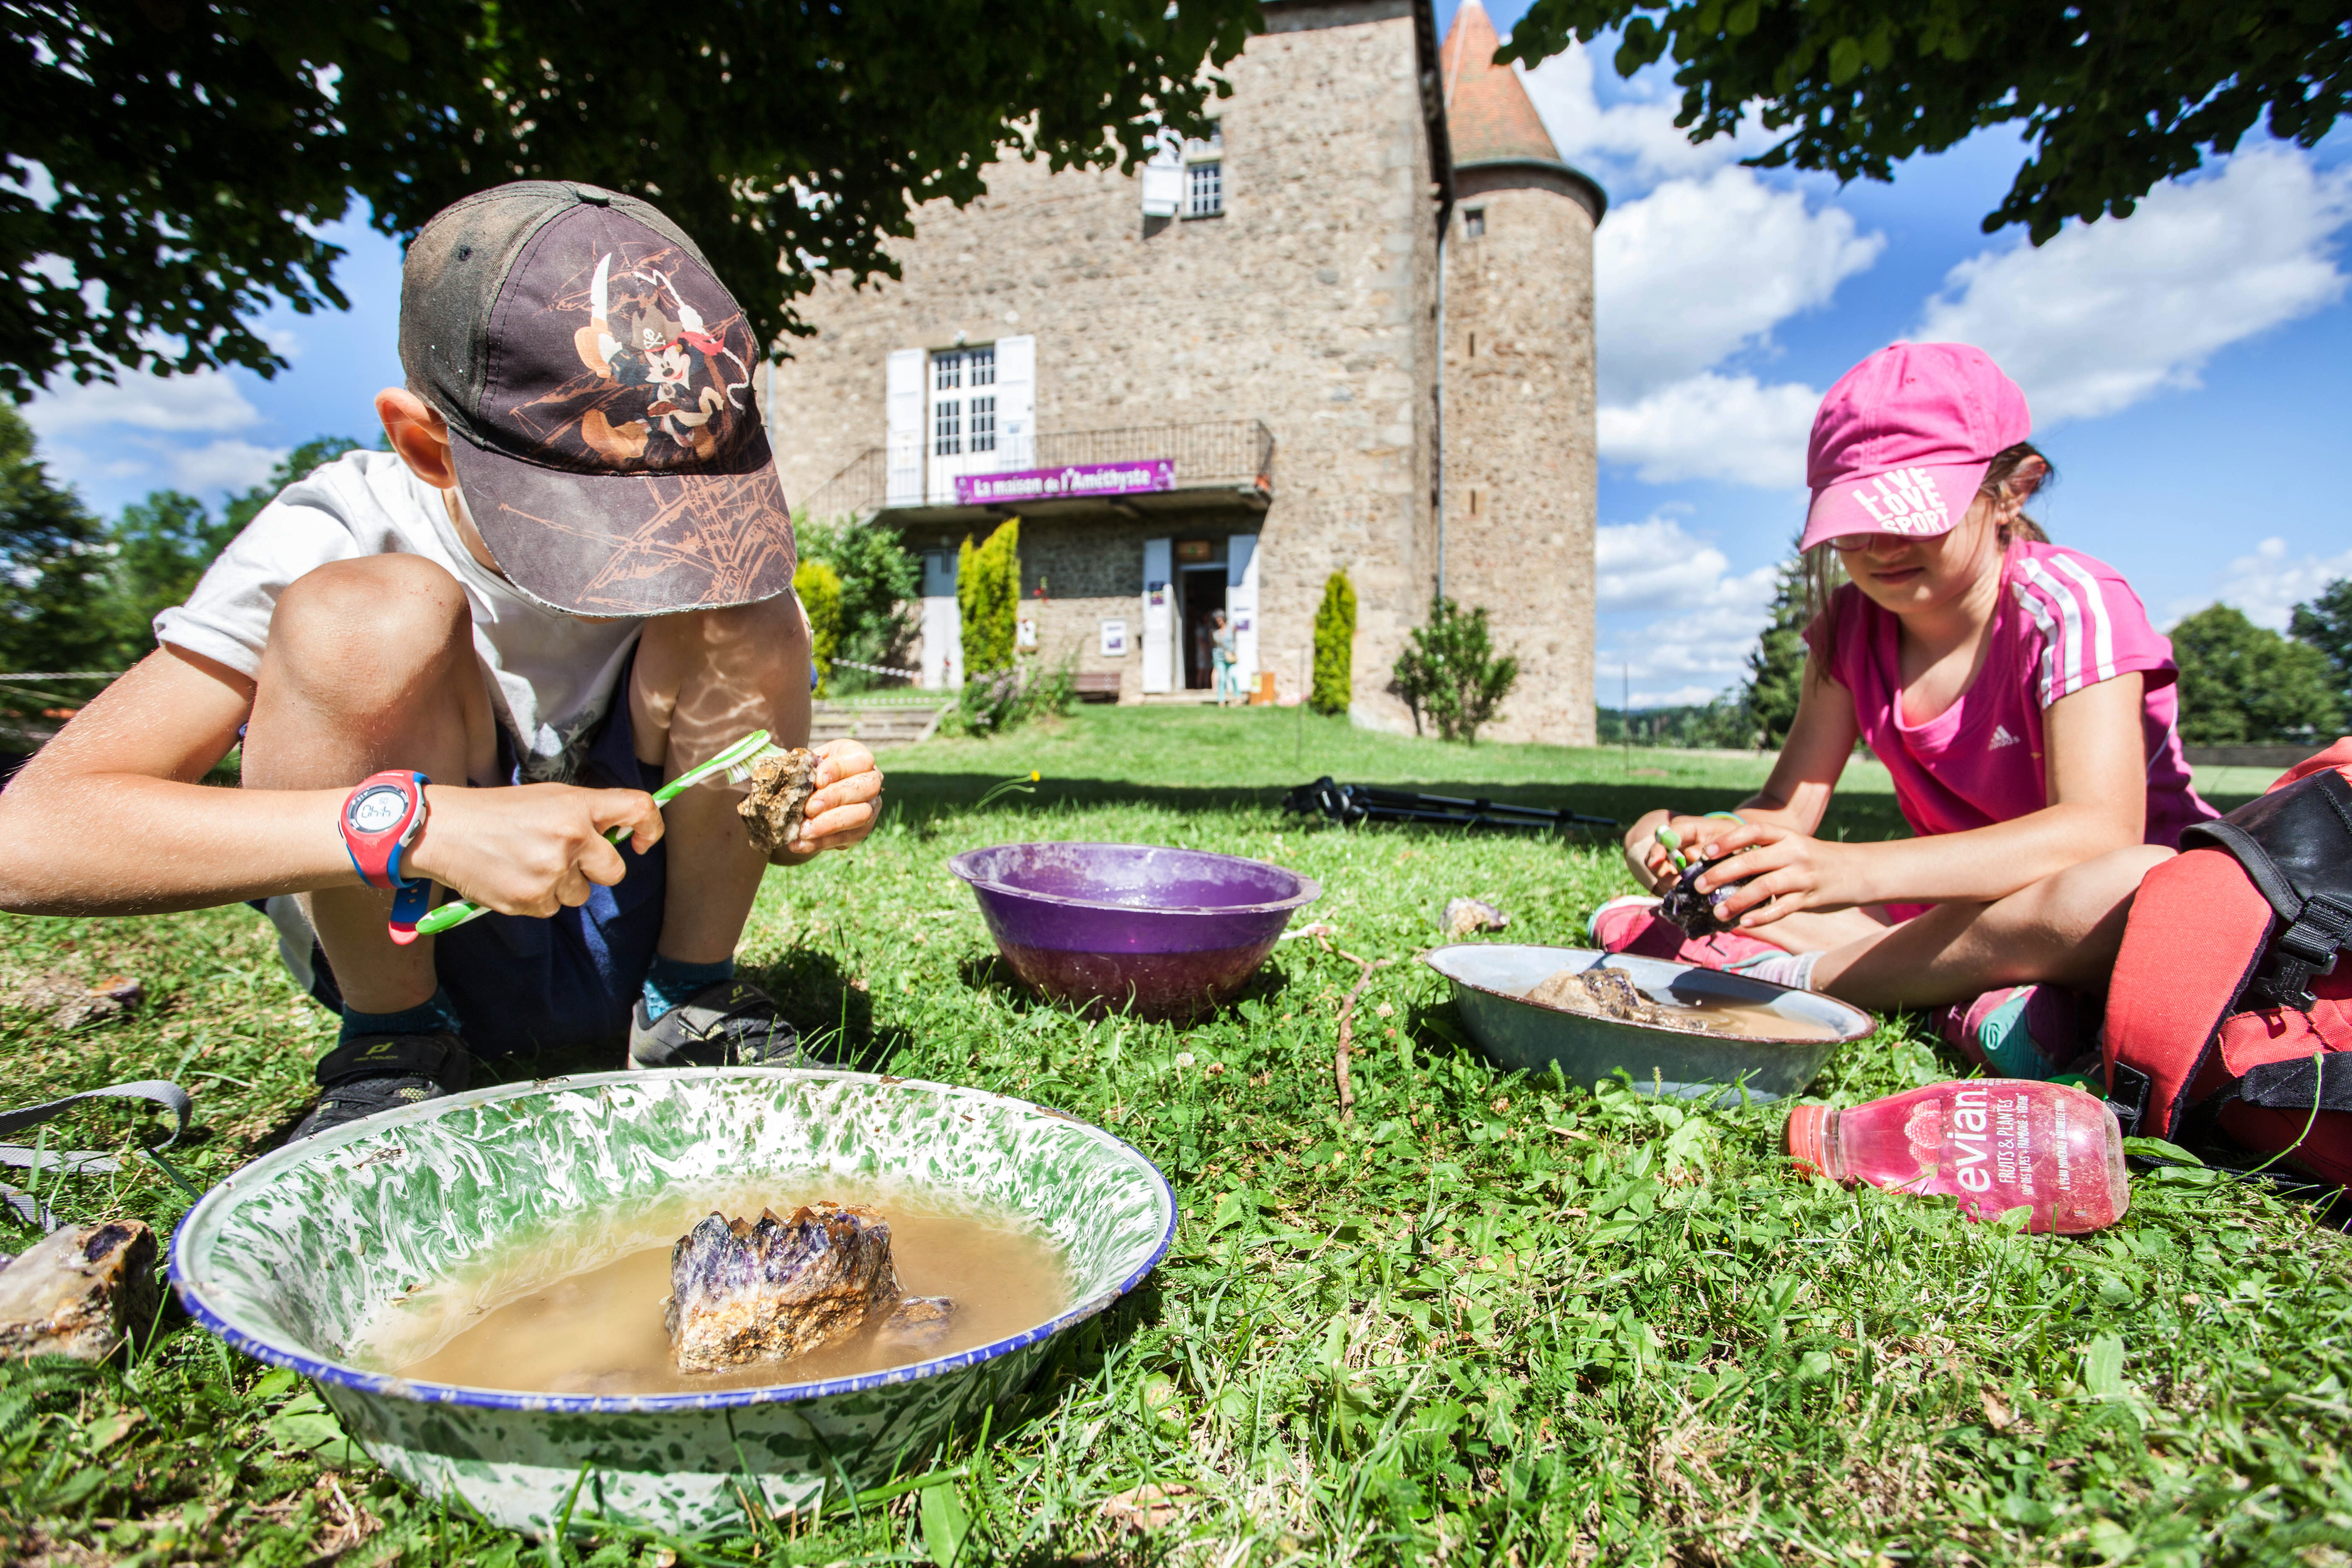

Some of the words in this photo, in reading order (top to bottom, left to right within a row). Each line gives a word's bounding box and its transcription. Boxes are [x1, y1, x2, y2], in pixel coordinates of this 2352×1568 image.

[973, 479, 992, 497] La
[992, 476, 1043, 496] maison
[1044, 477, 1060, 493] de
[1061, 467, 1151, 492] l'Améthyste
[1852, 467, 1933, 506] LIVE
[1865, 482, 1946, 522] LOVE
[1881, 508, 1951, 534] SPORT
[1996, 1099, 2014, 1136] PLANTES
[1998, 1138, 2015, 1149] &
[2017, 1120, 2031, 1149] FRAMBOISE
[1997, 1150, 2017, 1183] FRUITS
[2019, 1156, 2031, 1172] ALPES
[2021, 1173, 2033, 1184] DES
